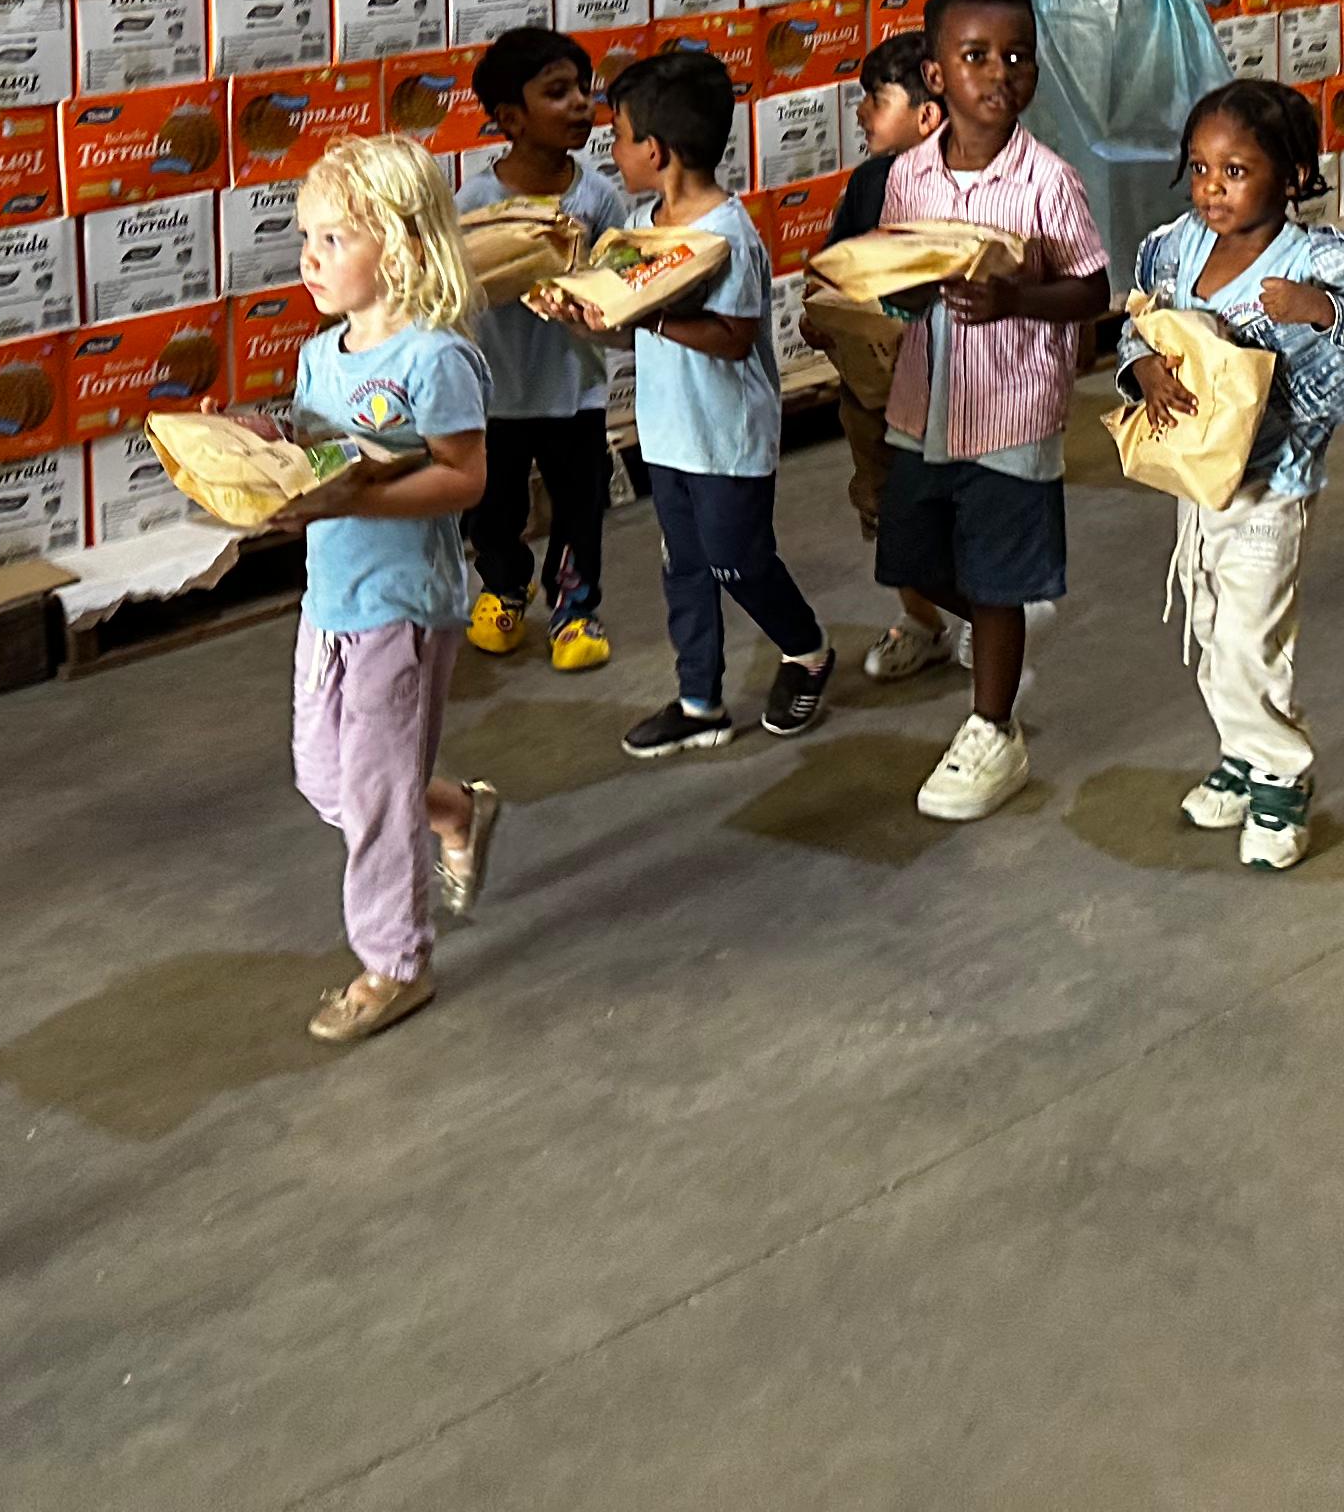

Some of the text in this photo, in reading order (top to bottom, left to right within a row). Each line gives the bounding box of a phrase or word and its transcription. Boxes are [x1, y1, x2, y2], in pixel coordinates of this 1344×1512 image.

[77, 138, 173, 167] Torrada
[116, 210, 189, 238] Torrada
[77, 365, 170, 398] Torrada
